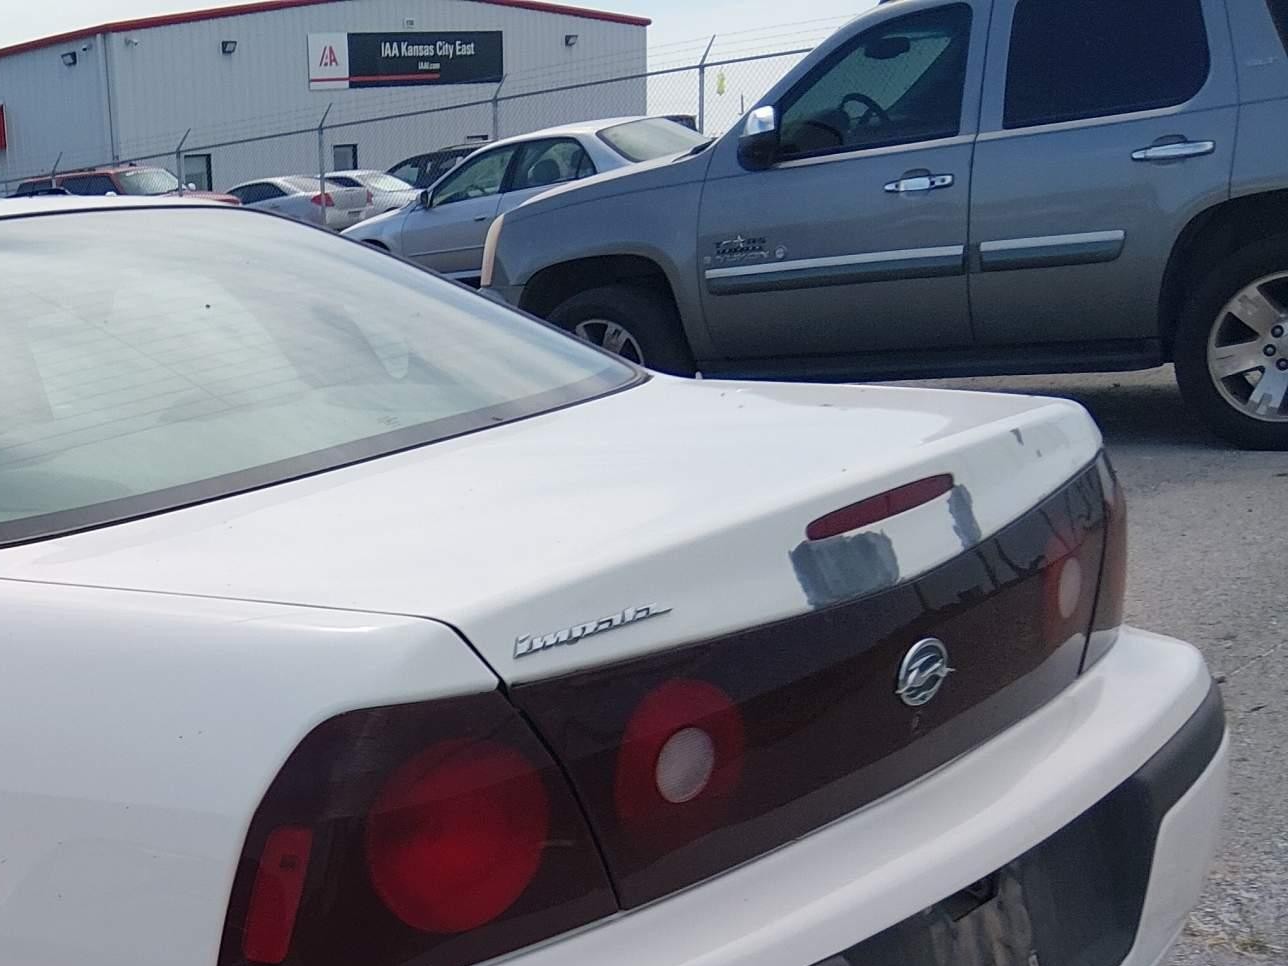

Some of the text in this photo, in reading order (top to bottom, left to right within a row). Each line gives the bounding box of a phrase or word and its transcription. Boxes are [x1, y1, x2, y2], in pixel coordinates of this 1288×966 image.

[381, 40, 476, 59] IAA Kansas City East
